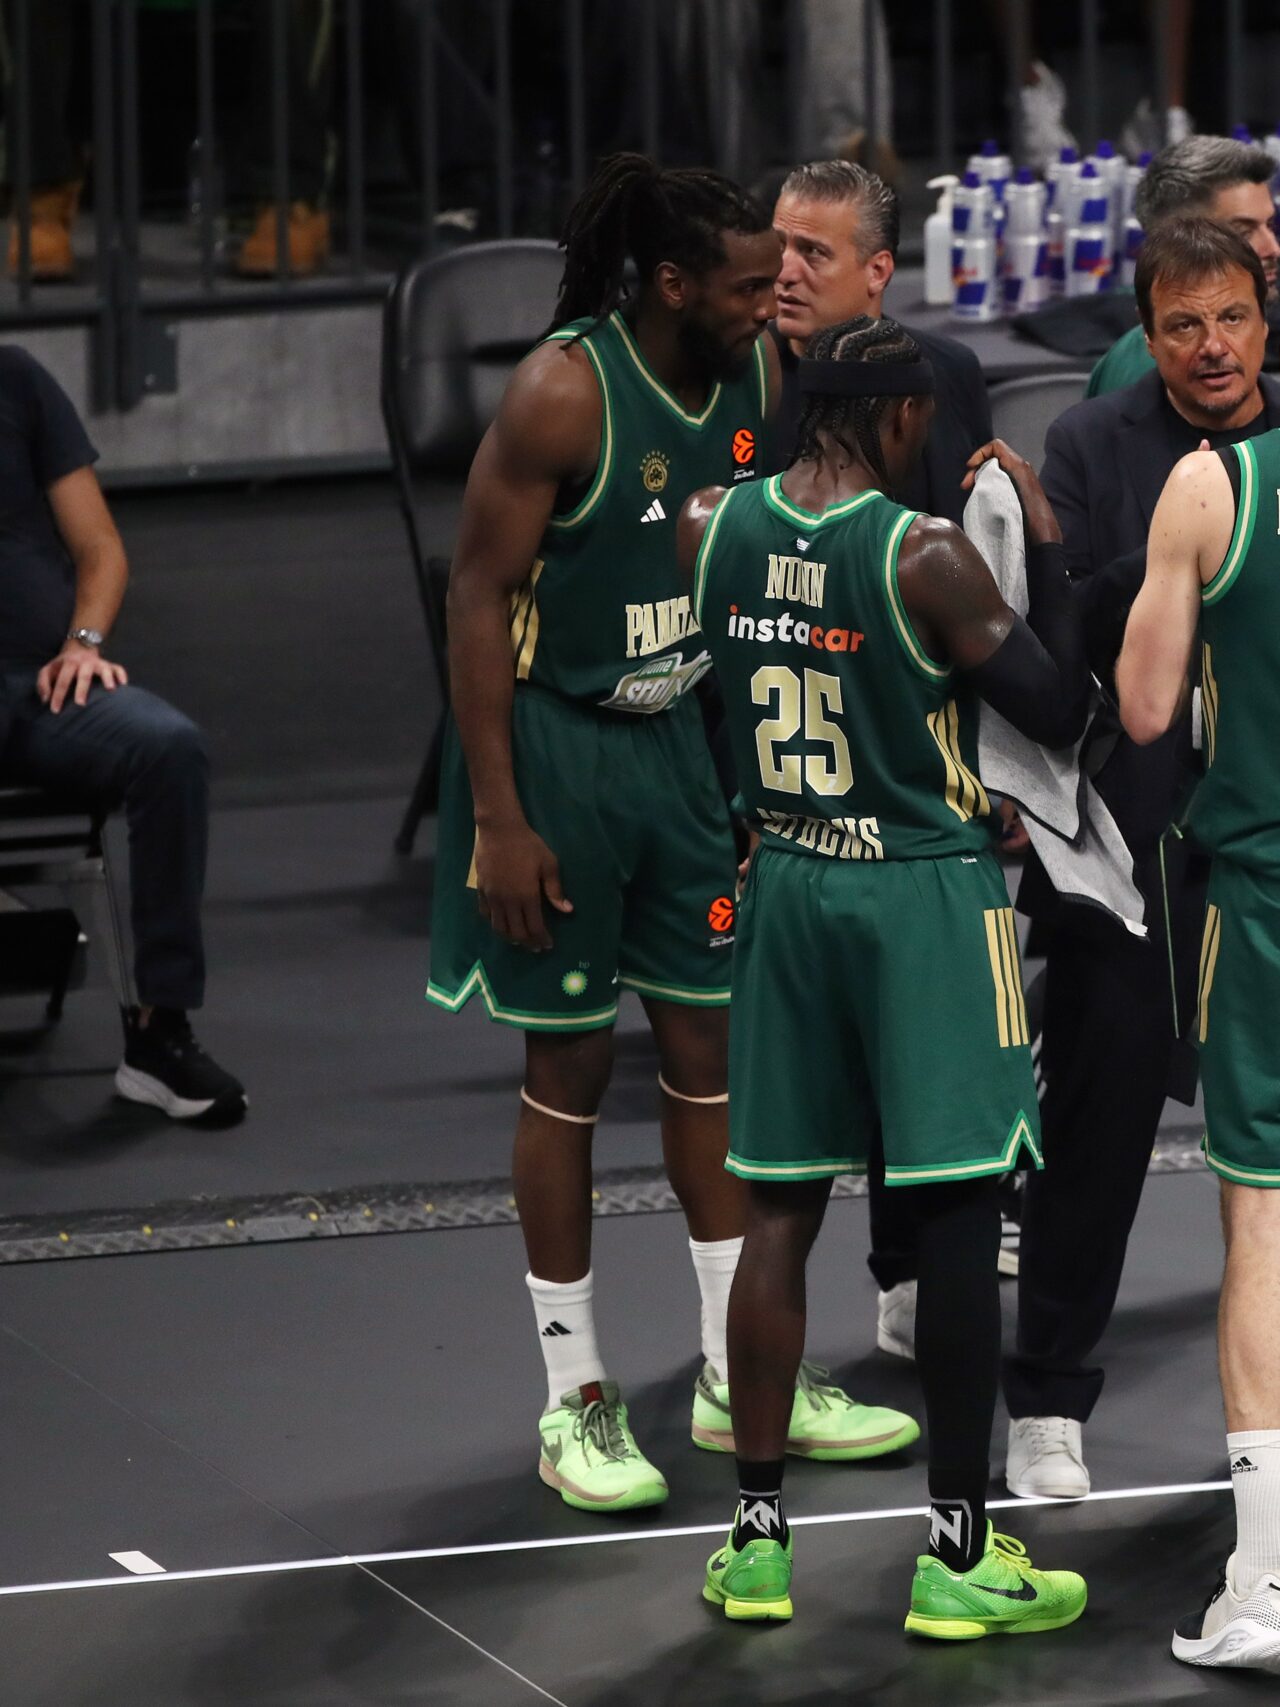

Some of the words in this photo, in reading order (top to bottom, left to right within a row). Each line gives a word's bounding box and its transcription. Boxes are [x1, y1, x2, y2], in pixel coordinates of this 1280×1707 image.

[764, 553, 828, 609] NUNN
[728, 604, 864, 653] instacar
[751, 666, 854, 796] 25
